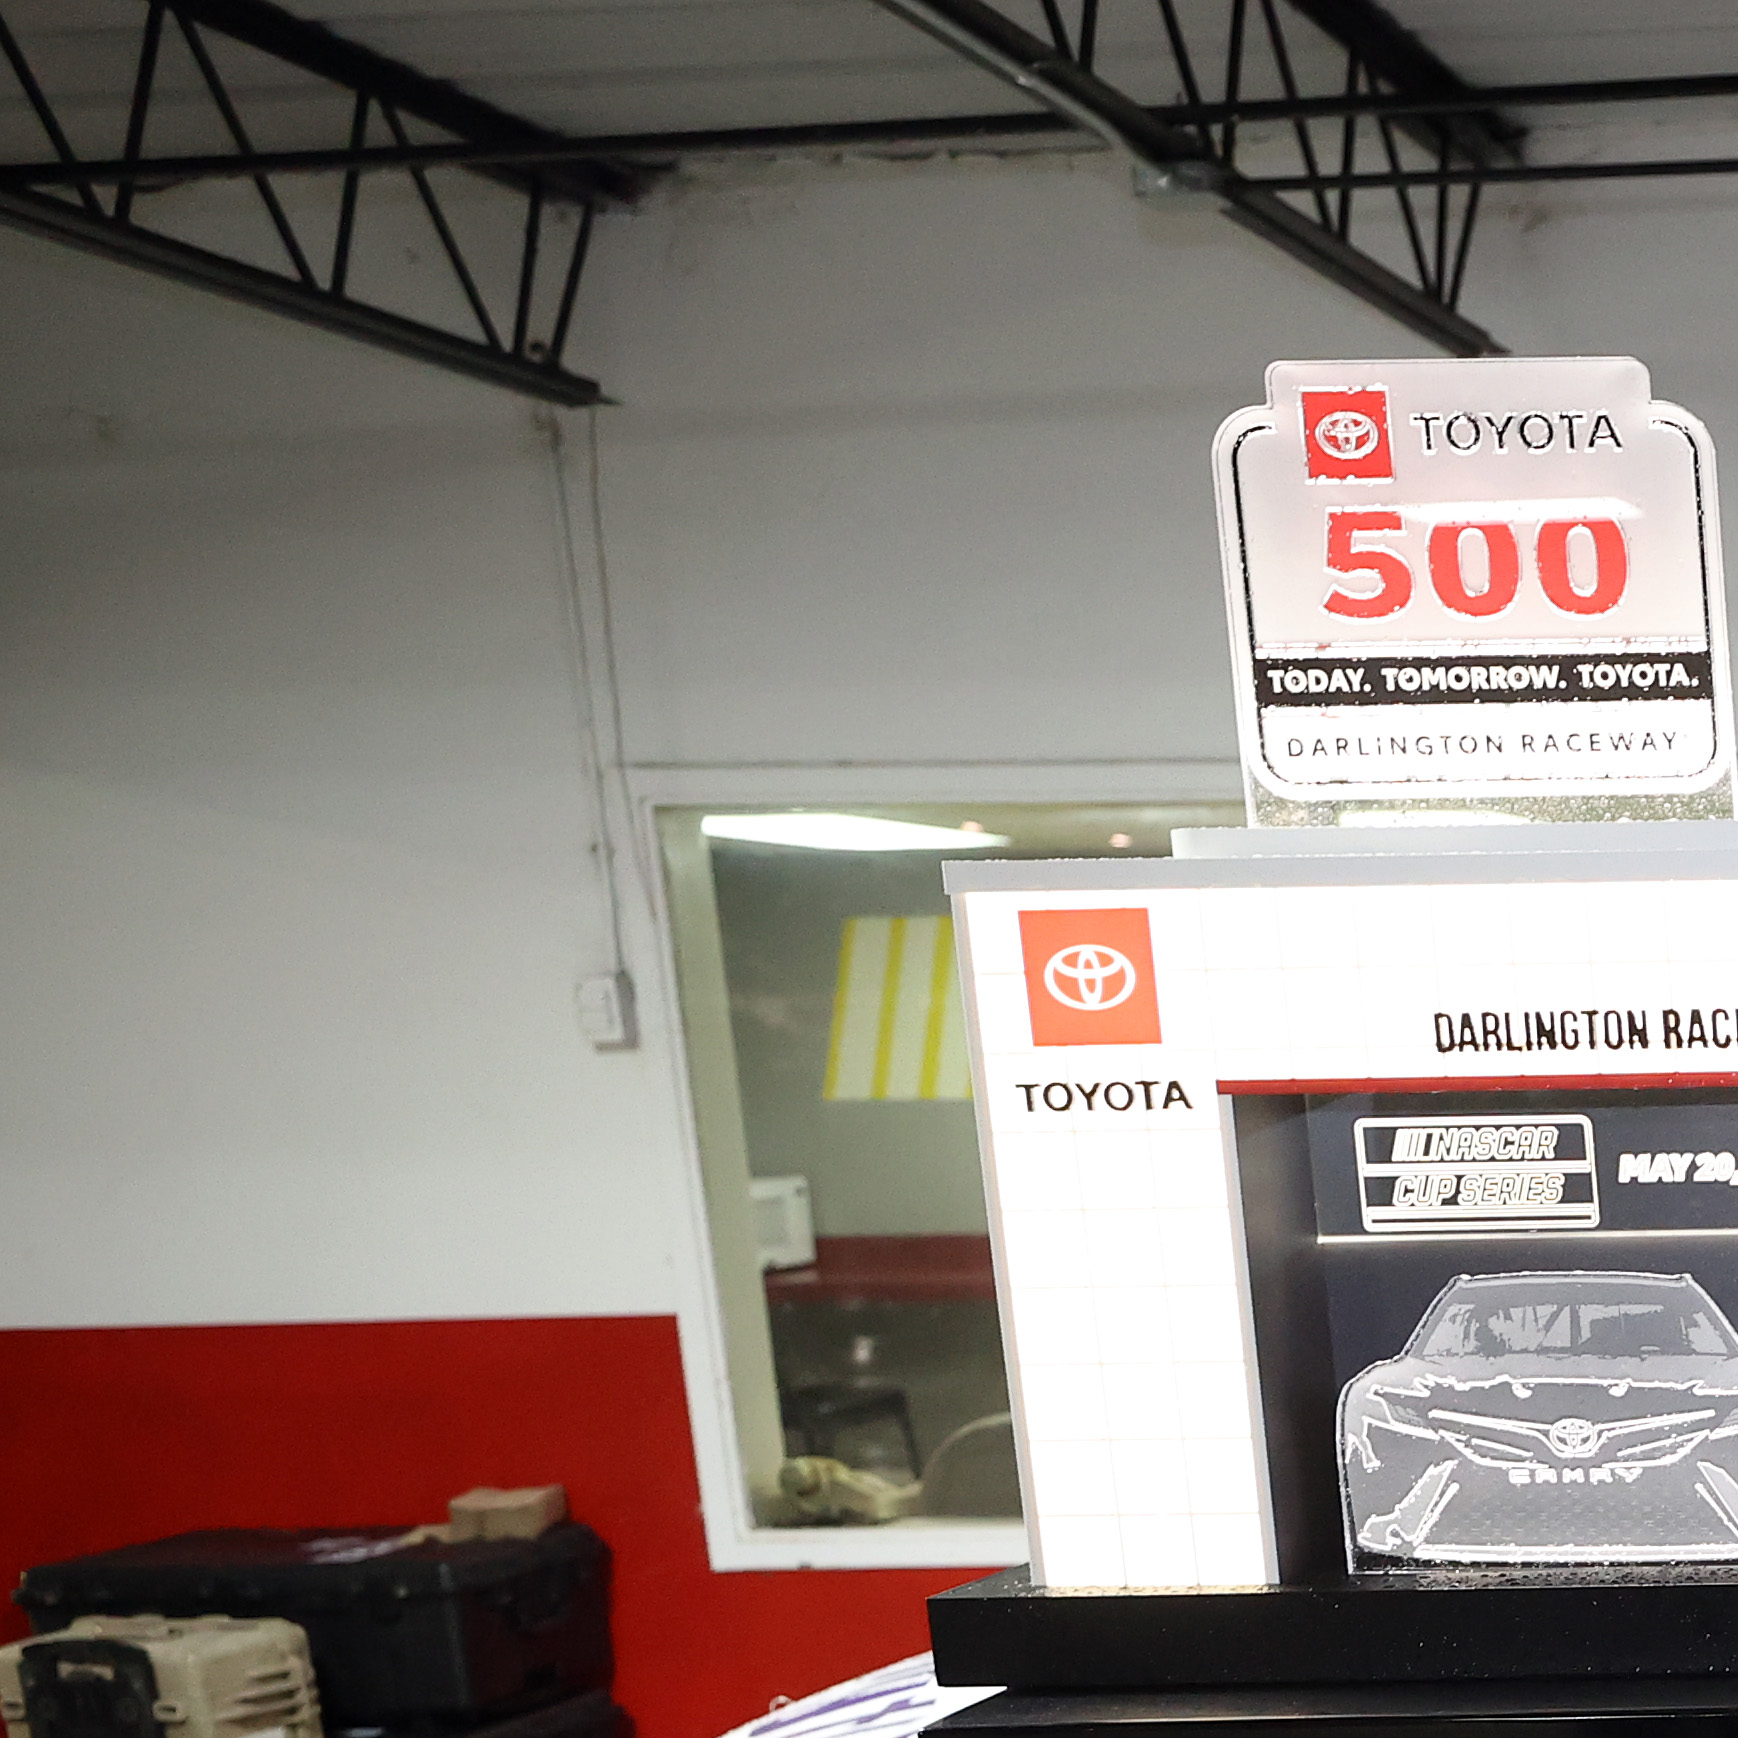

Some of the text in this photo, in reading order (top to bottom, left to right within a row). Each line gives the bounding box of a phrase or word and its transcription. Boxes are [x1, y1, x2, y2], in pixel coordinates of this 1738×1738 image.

[1410, 412, 1624, 454] TOYOTA
[1318, 503, 1630, 623] 500
[1268, 662, 1700, 694] TODAY. TOMORROW. TOYOTA.
[1288, 732, 1680, 758] DARLINGTON RACEWAY
[1435, 1010, 1649, 1054] DARLINGTON
[1017, 1081, 1192, 1113] TOYOTA
[1434, 1126, 1559, 1161] NASCAR
[1618, 1153, 1693, 1183] MAY
[1393, 1173, 1565, 1207] CUP SERIES
